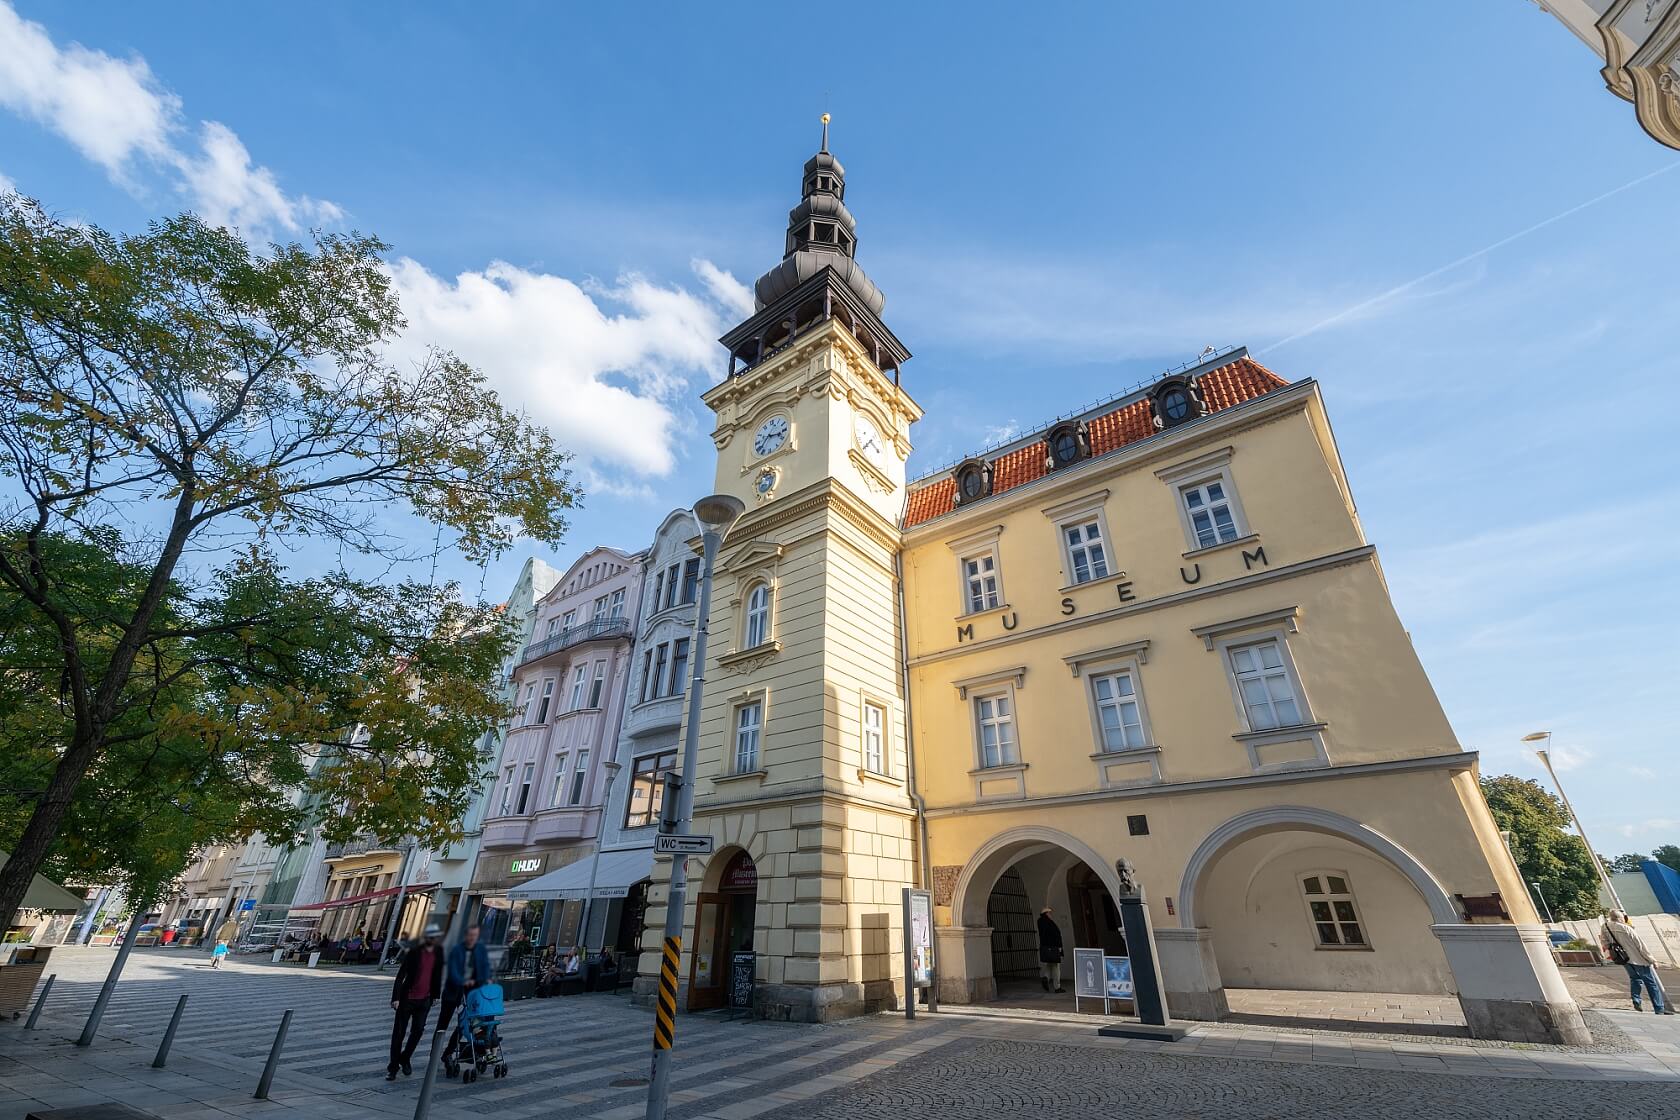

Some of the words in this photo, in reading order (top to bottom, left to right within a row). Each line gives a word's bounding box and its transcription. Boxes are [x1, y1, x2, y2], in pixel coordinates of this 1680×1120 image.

[957, 546, 1269, 643] MUSEUM
[661, 838, 677, 849] WC
[518, 859, 541, 872] HUDY
